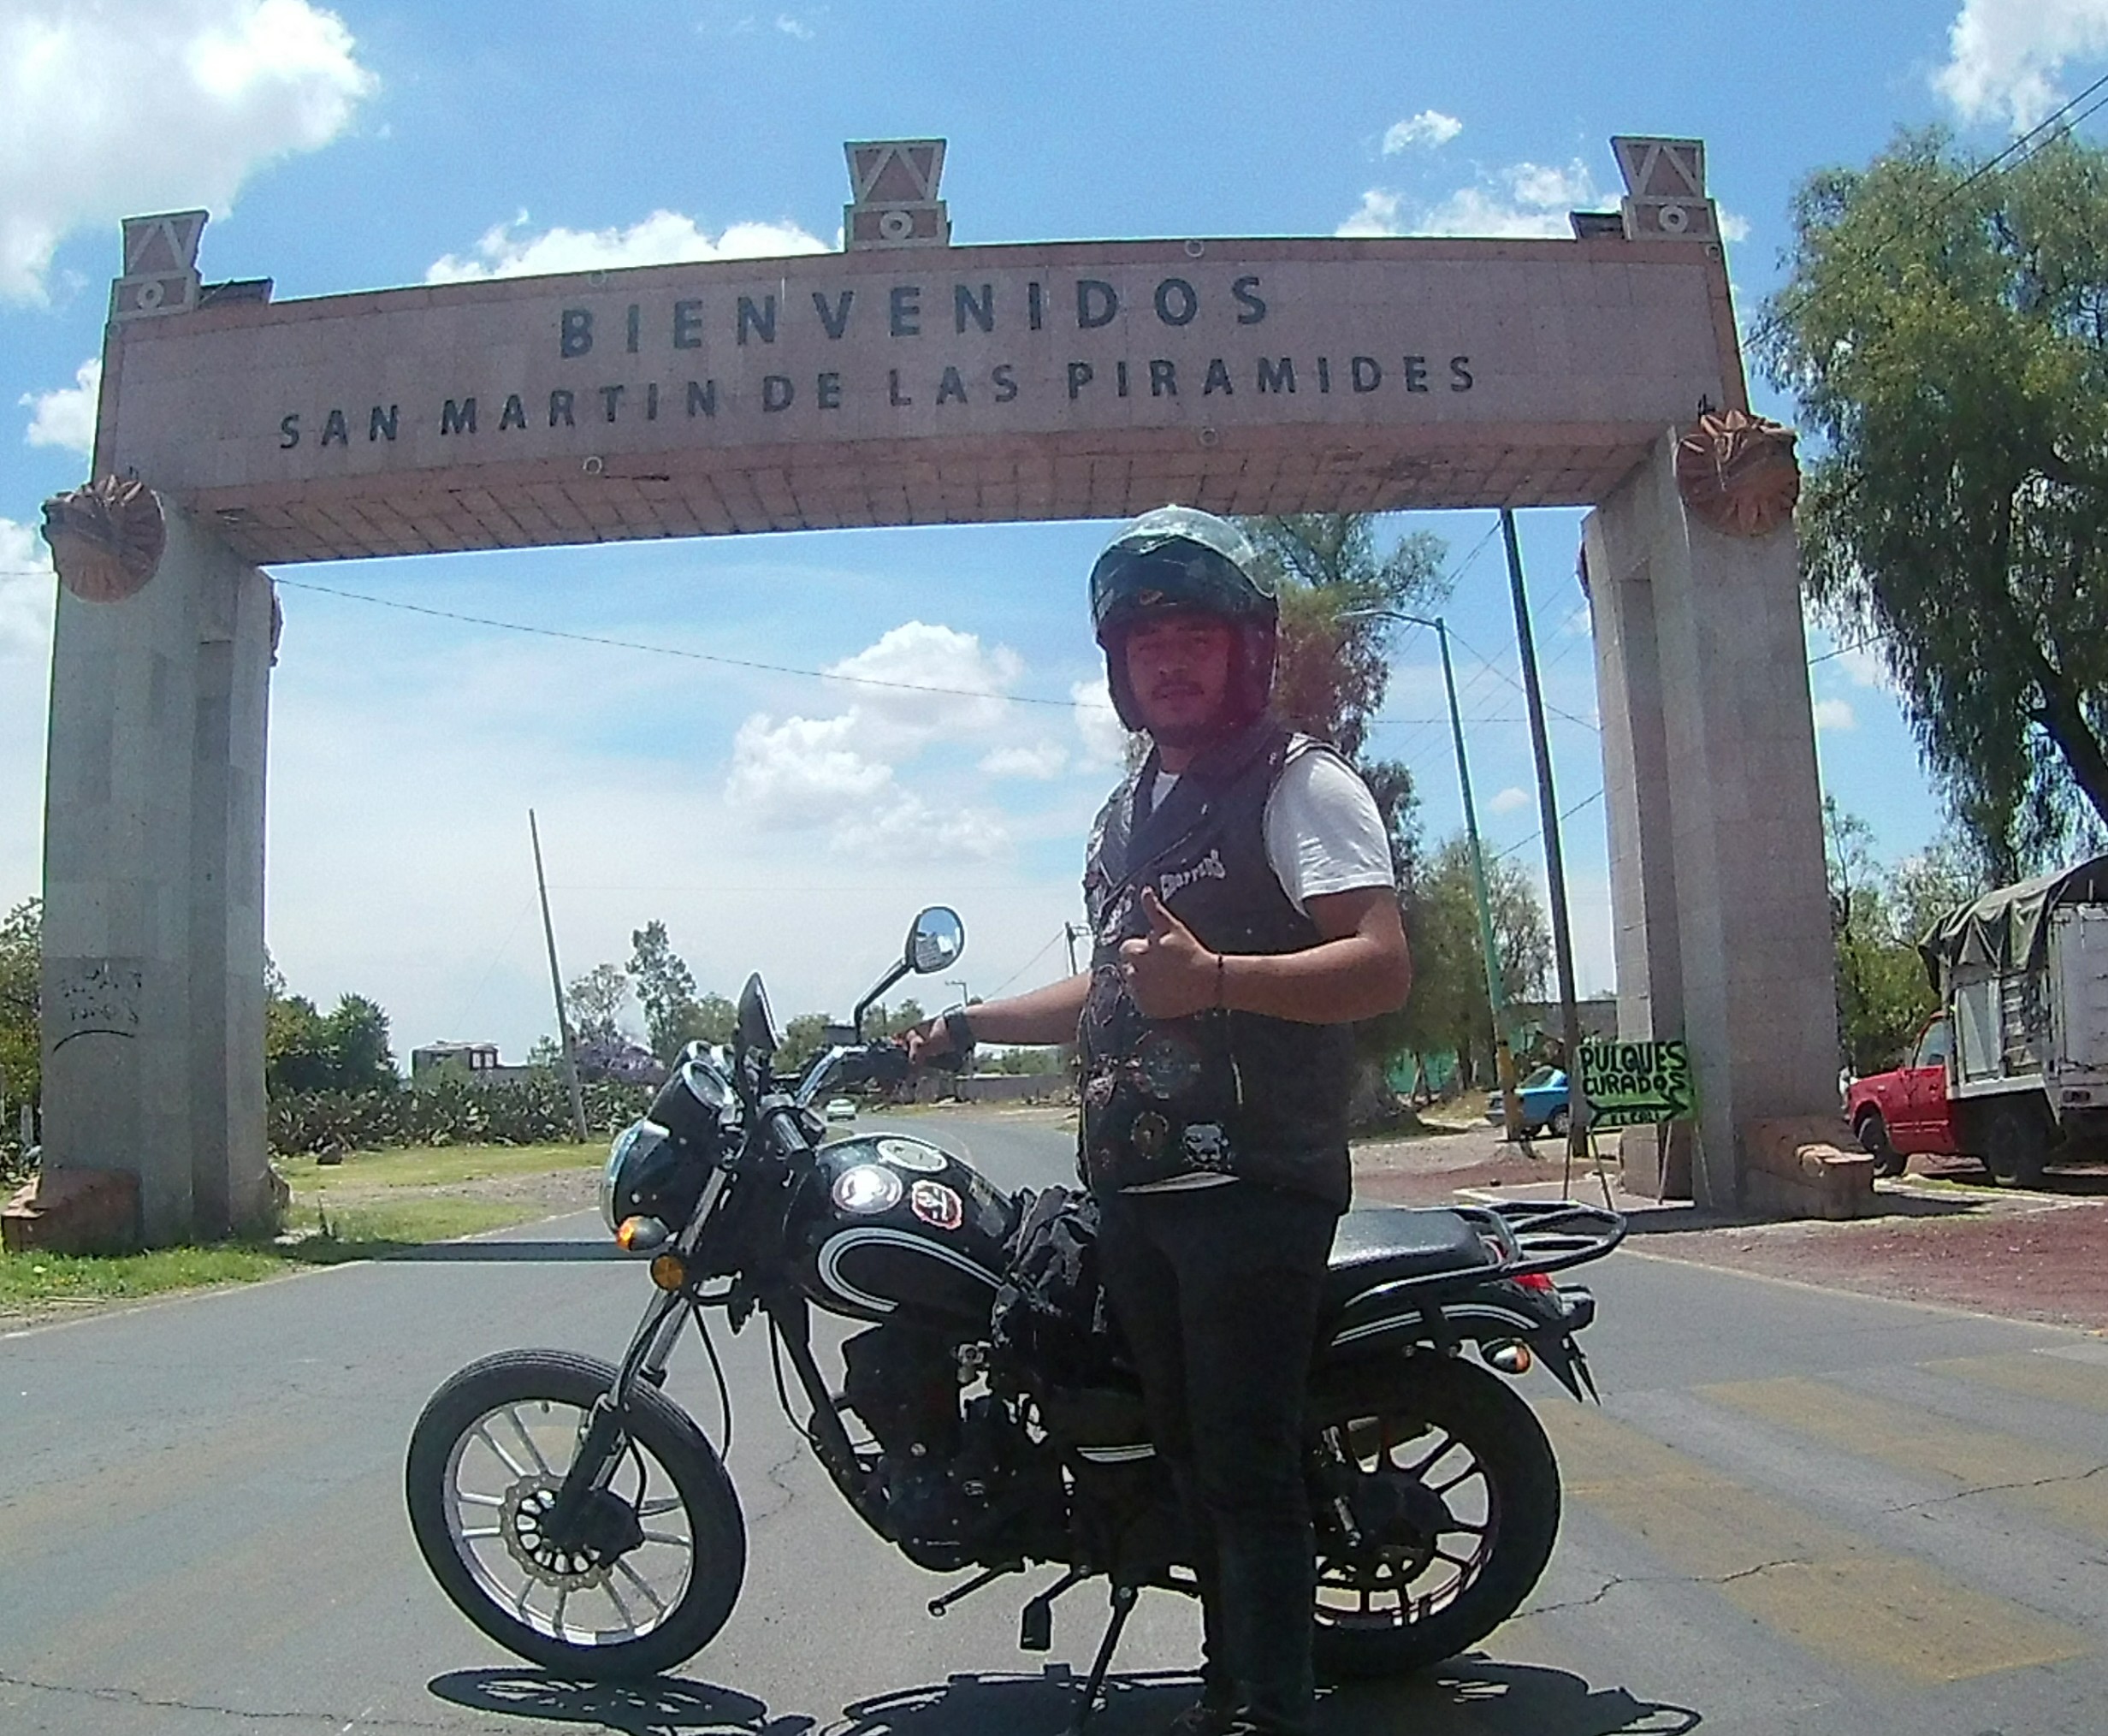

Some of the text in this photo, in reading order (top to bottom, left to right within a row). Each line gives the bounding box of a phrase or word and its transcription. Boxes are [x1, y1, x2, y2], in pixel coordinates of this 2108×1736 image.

[561, 276, 1267, 358] BIENVENIDOS
[280, 356, 1474, 450] SAN MARTIN DE LAS PIRAMIDES
[1579, 1040, 1687, 1075] PULQUES
[1583, 1072, 1686, 1096] CURADOS
